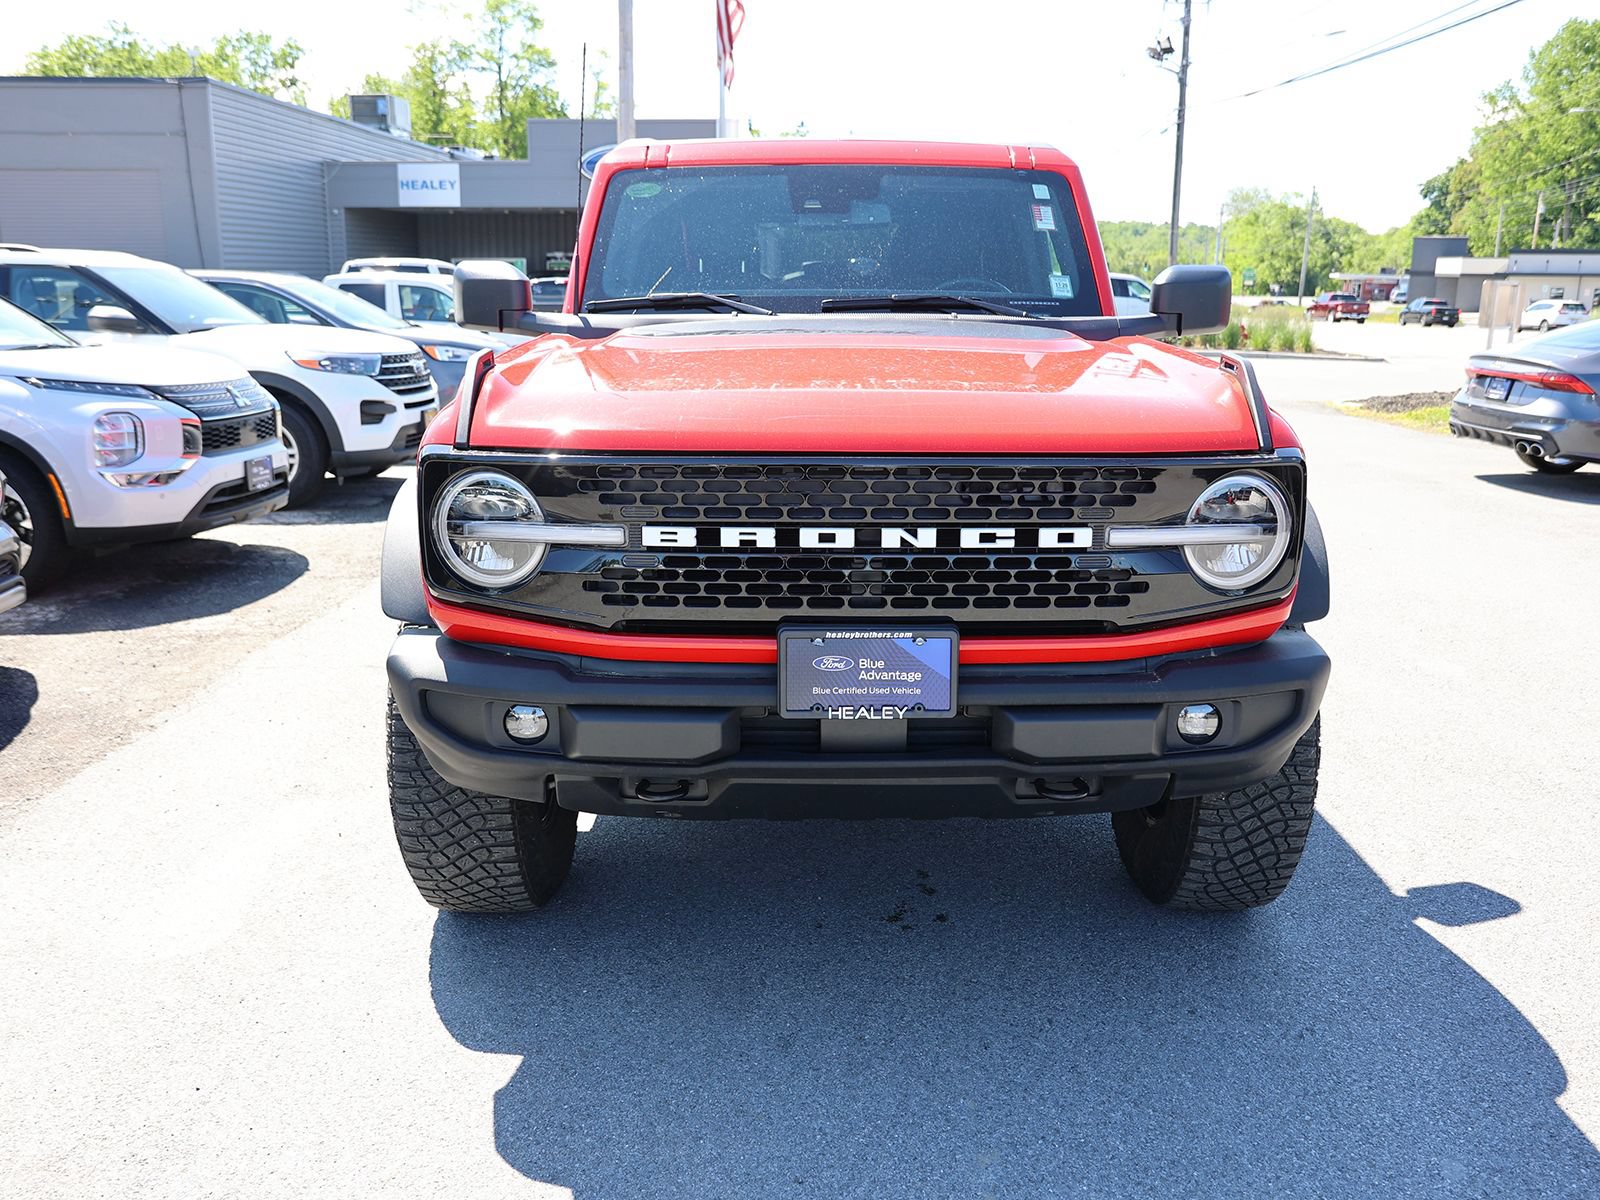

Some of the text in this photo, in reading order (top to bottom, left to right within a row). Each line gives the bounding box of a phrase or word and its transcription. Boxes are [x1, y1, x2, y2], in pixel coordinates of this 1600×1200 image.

[400, 180, 456, 190] HEALEY
[641, 526, 1093, 548] BRONCO
[825, 631, 913, 640] healeybrothers.com
[820, 658, 846, 669] Ford
[859, 658, 885, 669] Blue
[858, 670, 922, 682] Advantage
[812, 687, 921, 695] Blue Certified Used Vehicle
[828, 706, 908, 719] HEALEY
